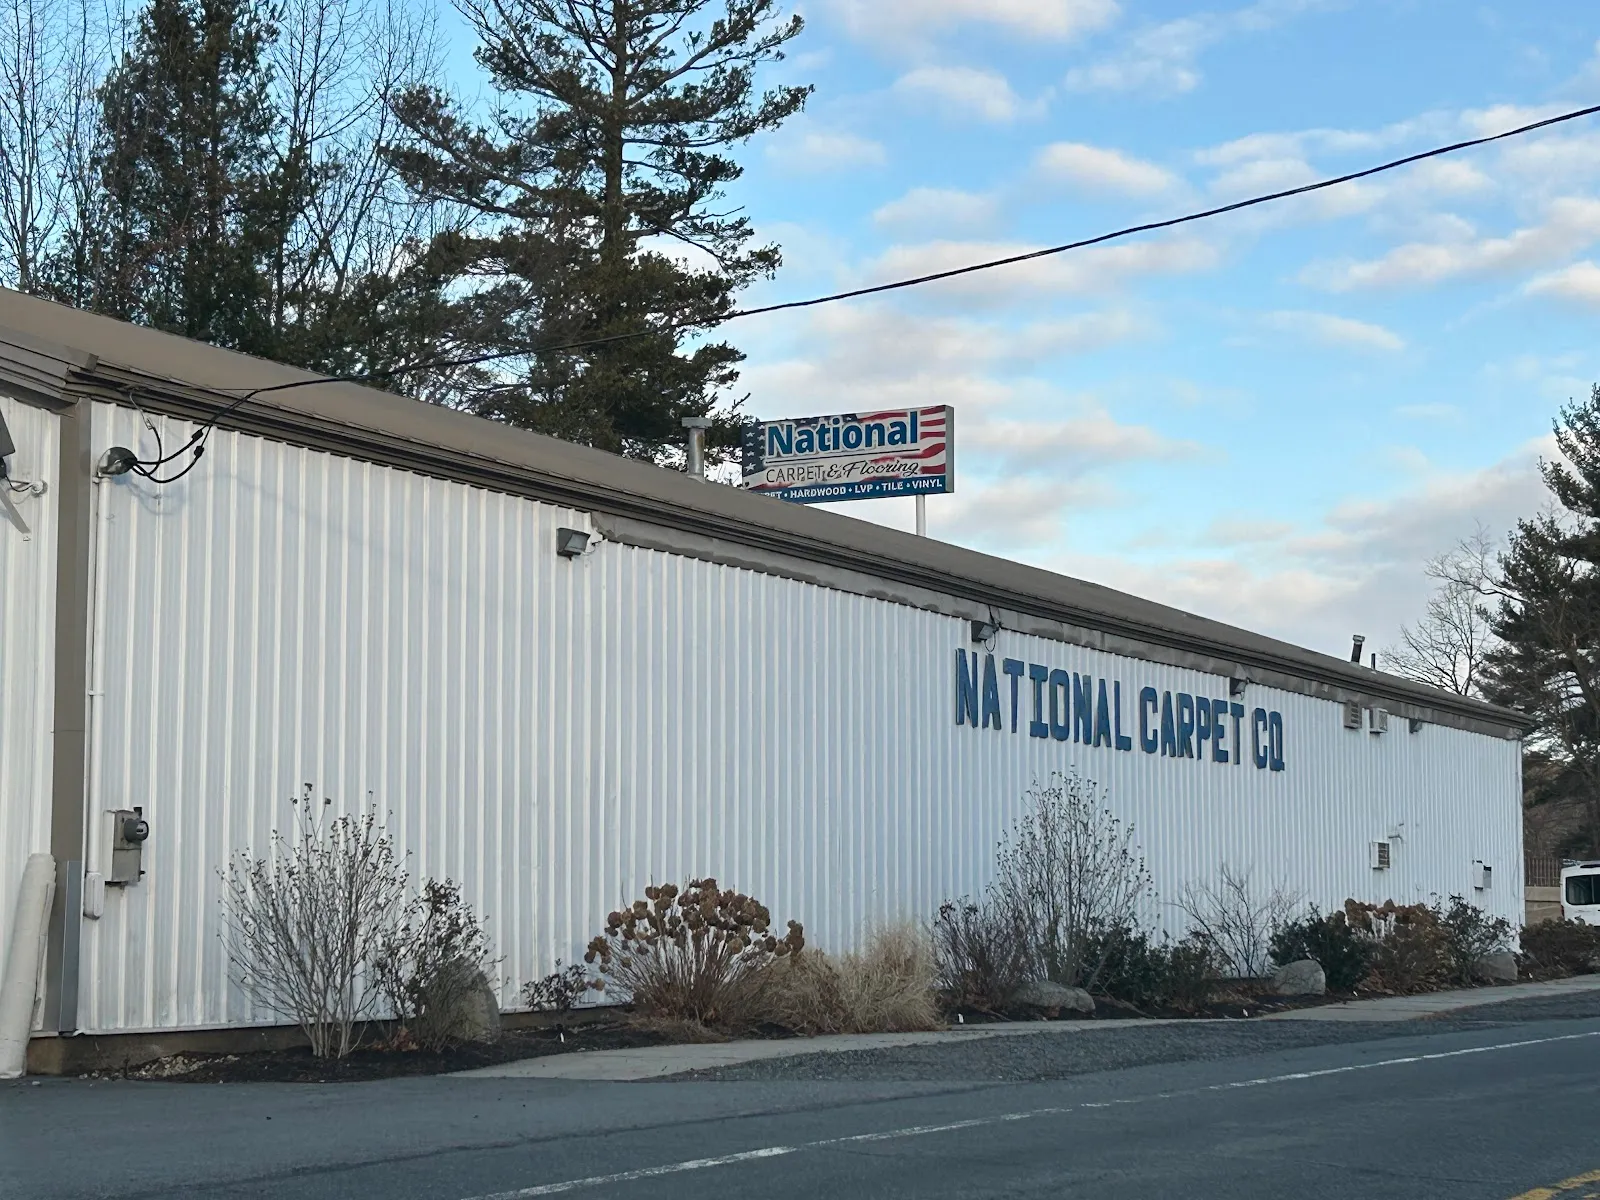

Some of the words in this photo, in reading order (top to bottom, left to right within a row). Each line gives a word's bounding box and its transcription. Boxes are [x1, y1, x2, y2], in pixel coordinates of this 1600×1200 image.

[768, 411, 918, 456] National
[766, 465, 824, 483] CARPET
[827, 464, 841, 480] &
[842, 460, 919, 479] Flooring
[790, 486, 846, 499] HARDWOOD
[855, 484, 873, 494] LVP
[881, 481, 904, 491] TILE
[912, 479, 942, 489] VINYL
[955, 648, 1131, 751] NATIONAL
[1140, 686, 1244, 765] CARPET
